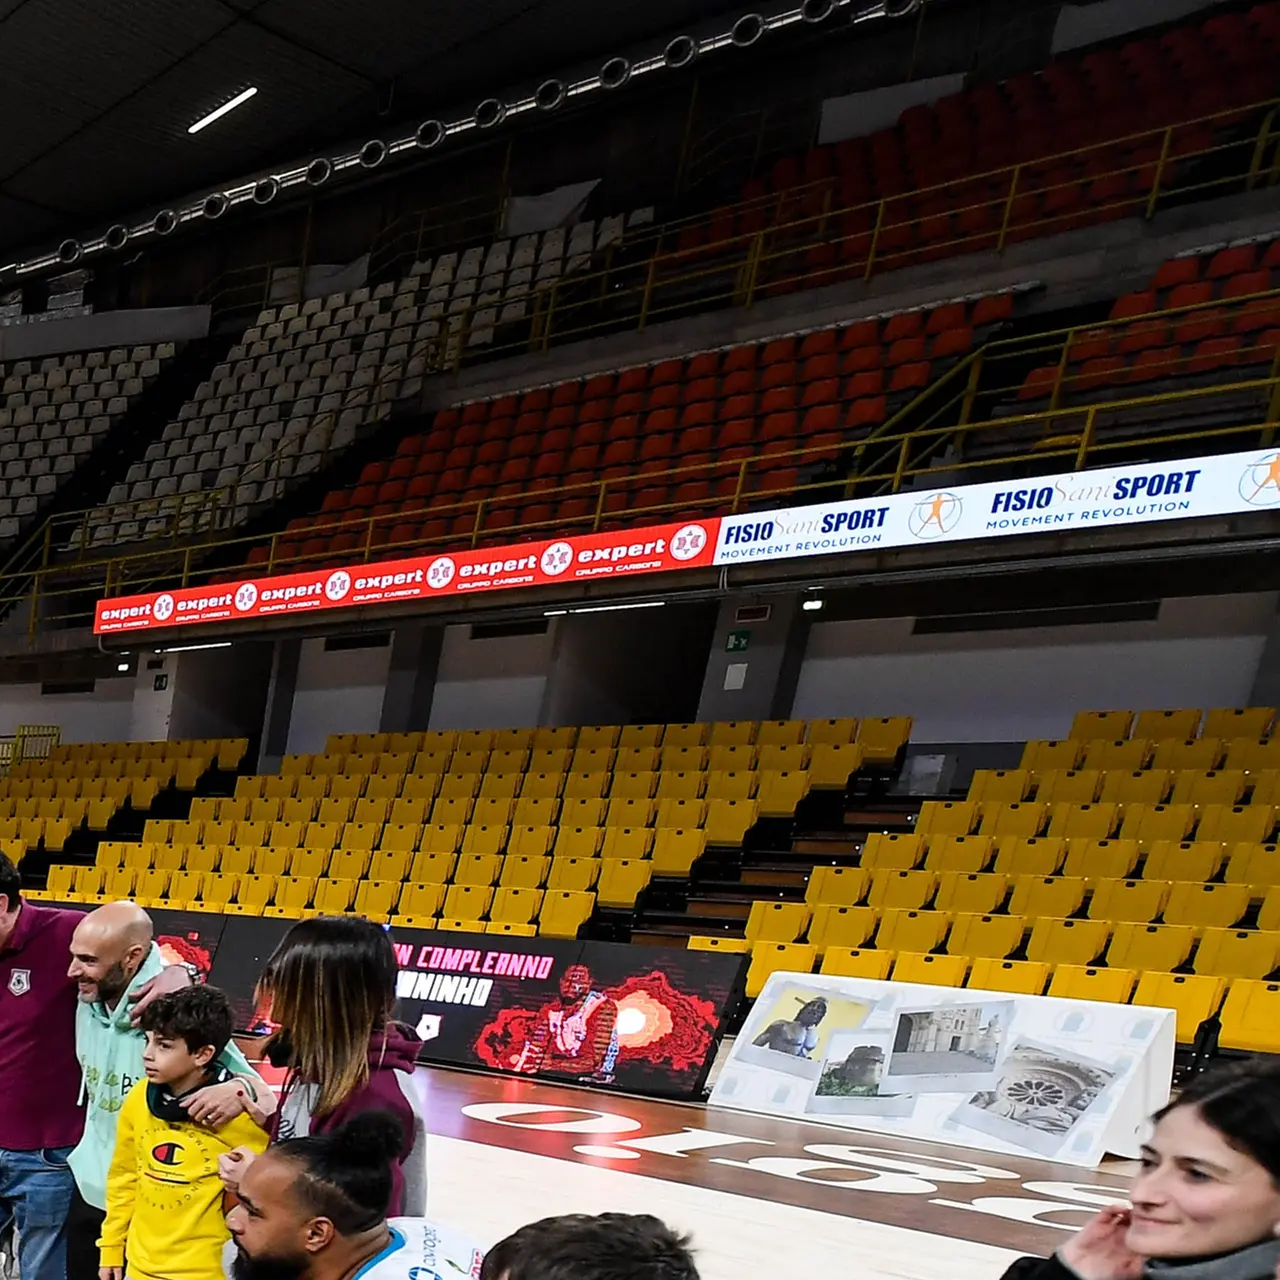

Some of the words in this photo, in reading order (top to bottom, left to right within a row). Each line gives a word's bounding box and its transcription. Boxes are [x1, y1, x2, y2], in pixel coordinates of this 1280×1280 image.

[985, 512, 1075, 531] MOVEMENT
[1080, 500, 1190, 524] REVOLUTION
[578, 538, 666, 563] expert
[720, 543, 792, 560] MOVEMENT
[796, 532, 882, 552] REVOLUTION
[459, 555, 537, 578] expert
[354, 569, 424, 590] expert
[176, 593, 233, 611] expert
[260, 582, 323, 602] expert
[101, 604, 152, 620] expert
[416, 945, 554, 980] COMPLEANNO
